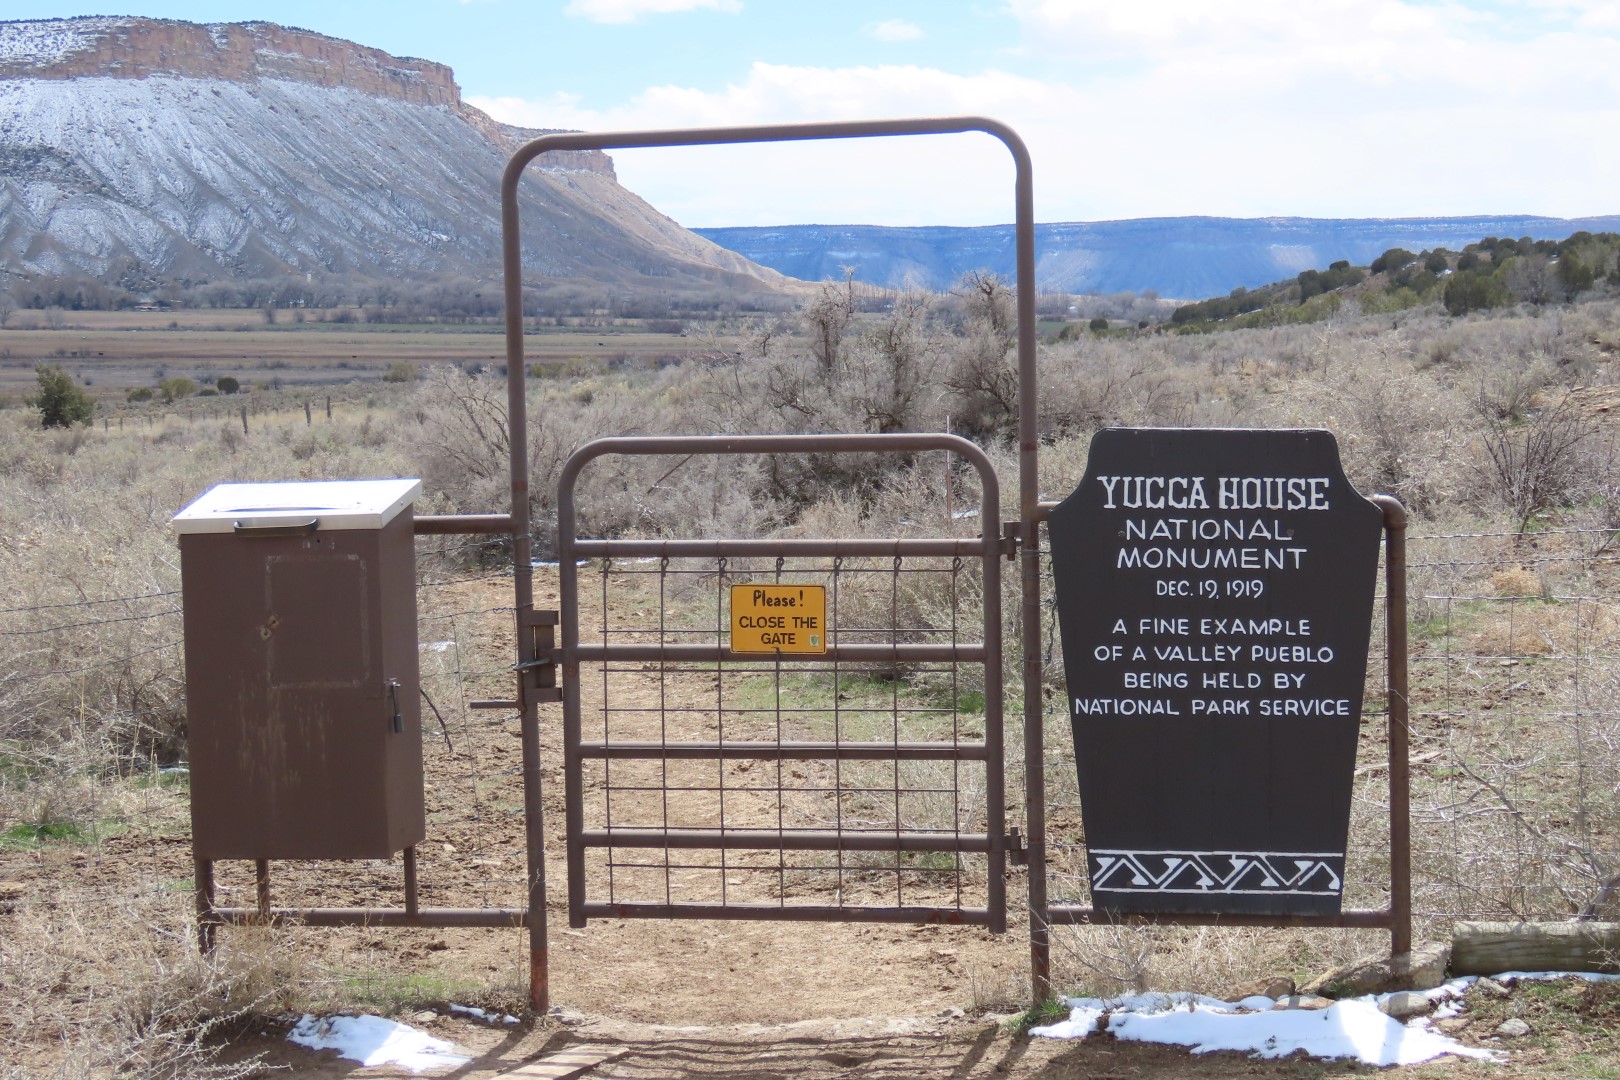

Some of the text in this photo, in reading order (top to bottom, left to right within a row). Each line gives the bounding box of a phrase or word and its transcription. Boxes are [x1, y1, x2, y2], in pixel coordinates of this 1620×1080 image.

[1097, 476, 1330, 510] YUCCA HOUSE
[1126, 519, 1292, 541] NATIONAL
[1117, 547, 1307, 569] MONUMENT
[1156, 580, 1264, 599] DEC. 19, 1919
[739, 616, 817, 628] CLOSE THE
[1112, 619, 1311, 636] A FINE EXAMPLE
[761, 633, 796, 644] GATE
[1094, 646, 1334, 663] OF A VALLEY PUEBLO
[1124, 673, 1306, 689] BEING HELD BY
[1075, 699, 1349, 716] NATIONAL PARK SERVICE
